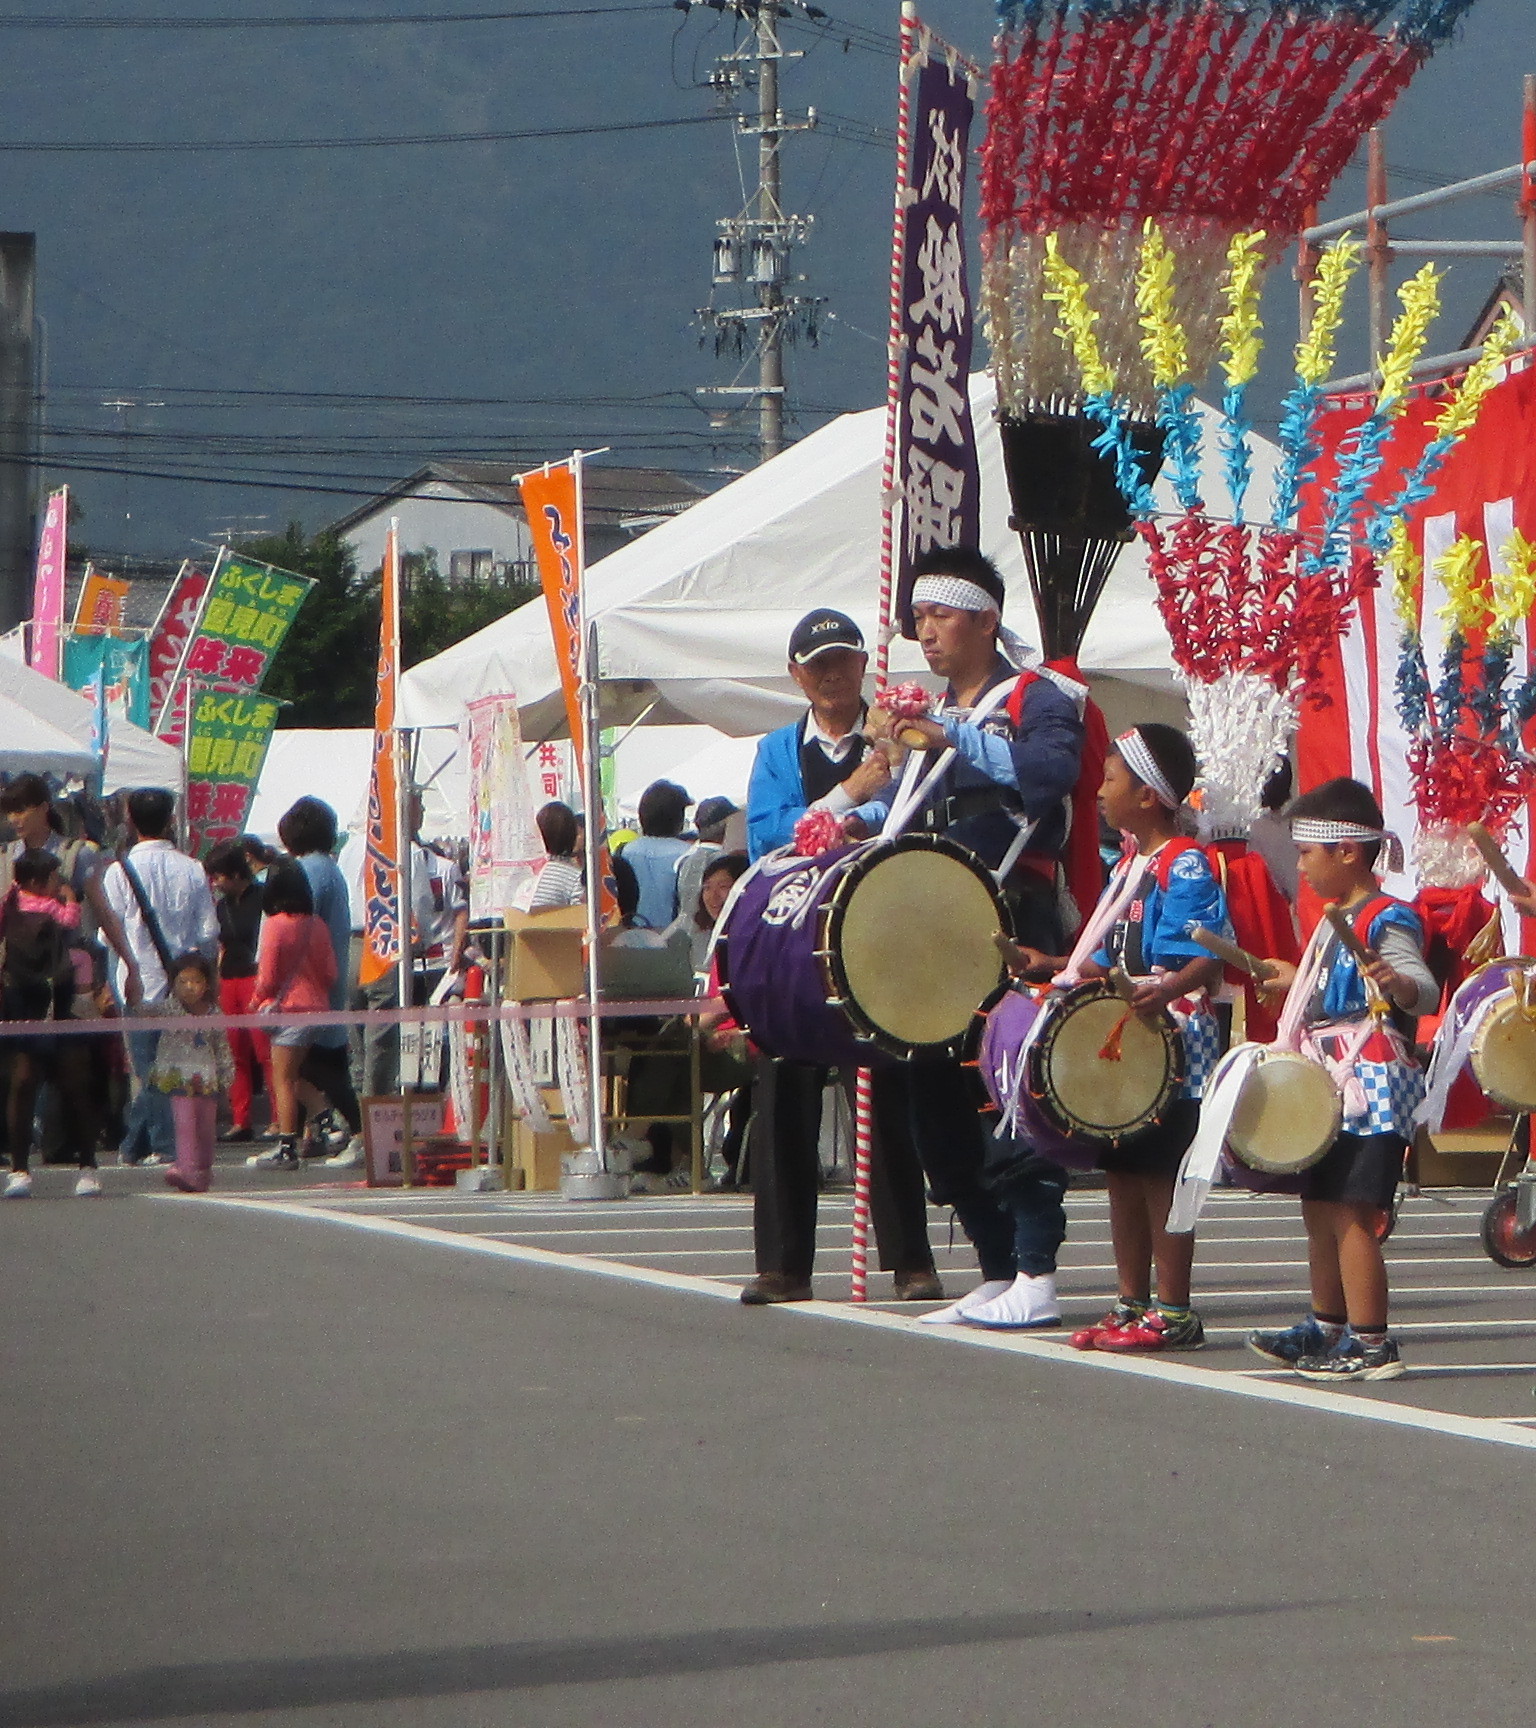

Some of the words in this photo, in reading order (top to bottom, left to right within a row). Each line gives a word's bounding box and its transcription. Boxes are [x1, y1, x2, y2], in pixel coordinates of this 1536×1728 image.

[220, 565, 305, 607] ふくしま
[810, 618, 840, 636] XXIO
[185, 634, 268, 685] 味来
[196, 695, 278, 729] ふくしま
